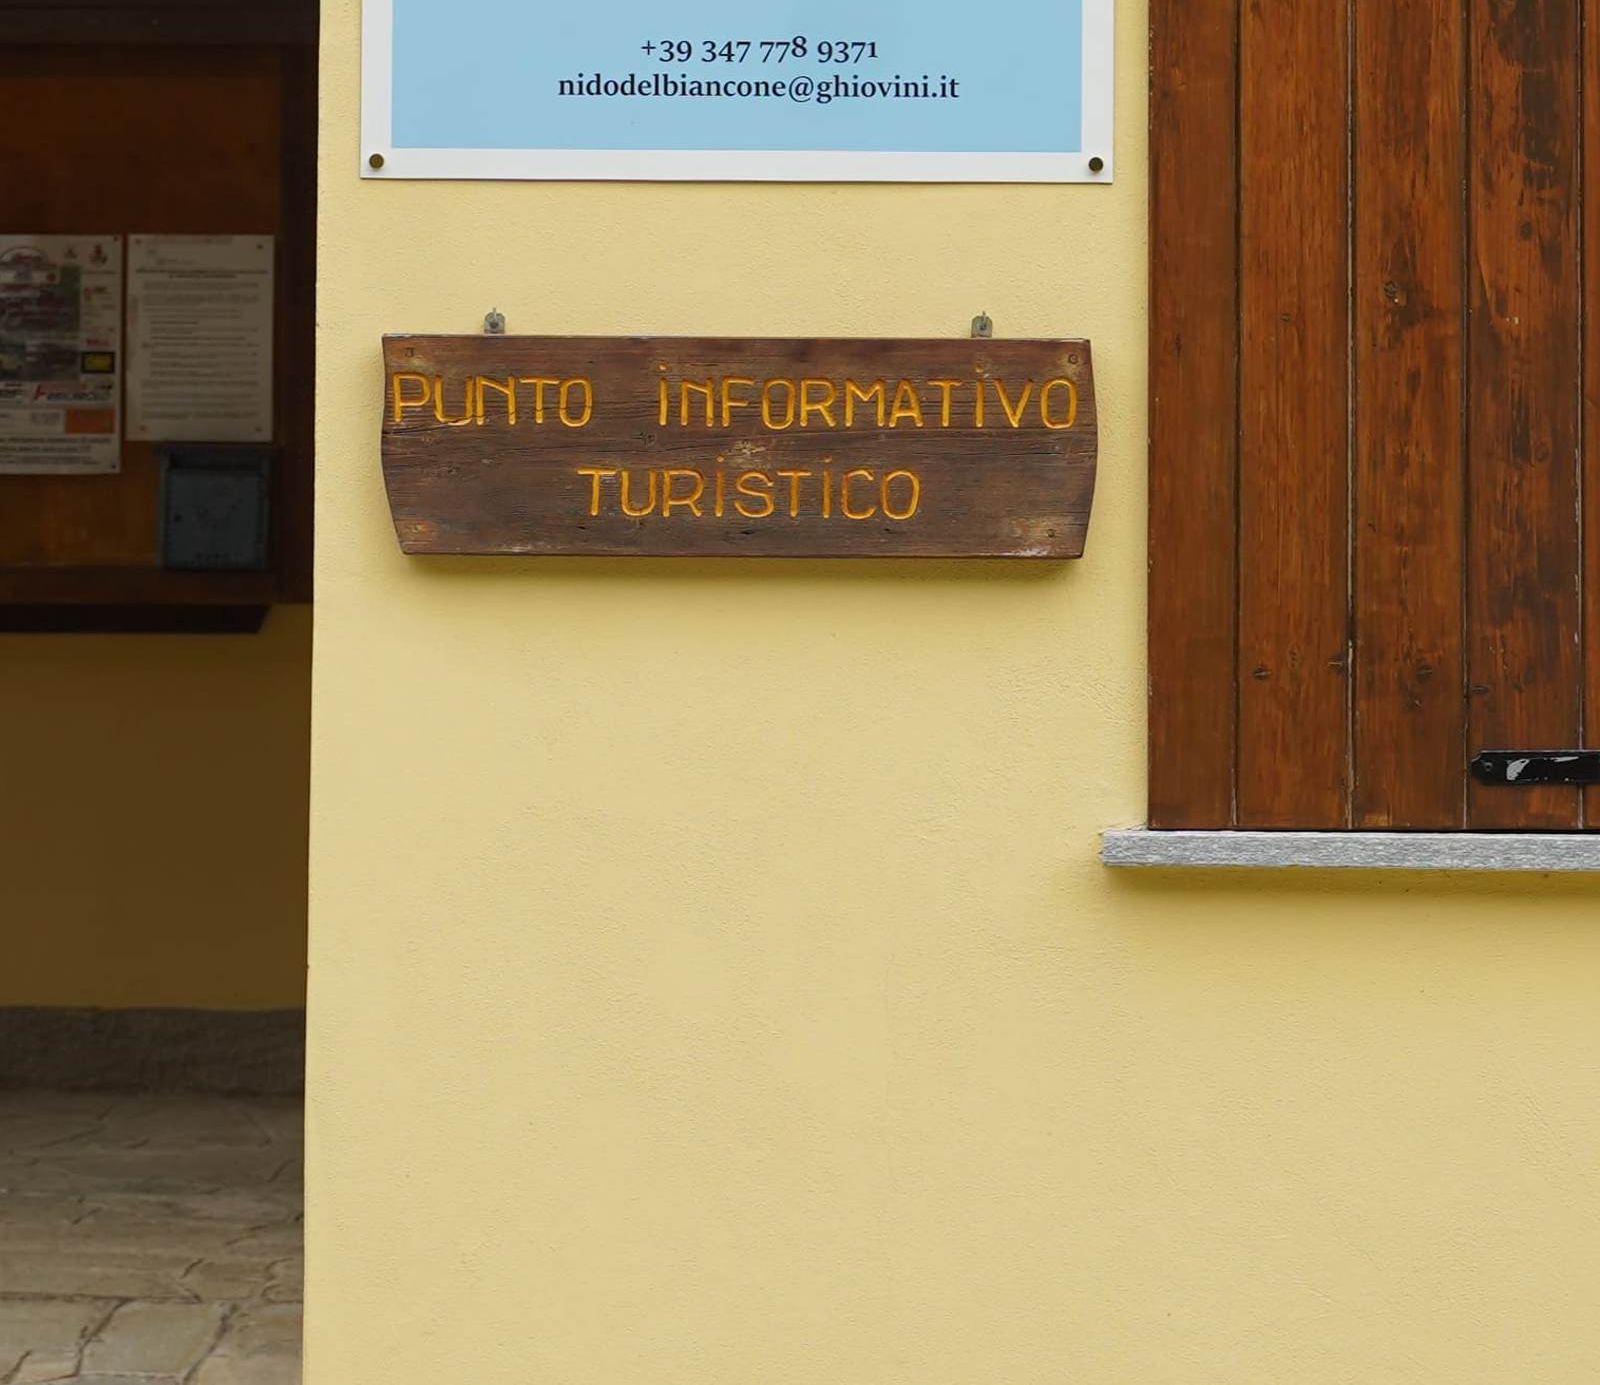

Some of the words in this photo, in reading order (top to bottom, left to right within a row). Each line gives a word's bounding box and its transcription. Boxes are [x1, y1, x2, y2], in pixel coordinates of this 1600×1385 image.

[640, 39, 693, 63] +39
[701, 40, 752, 64] 347
[759, 35, 808, 64] 778
[817, 40, 878, 64] 9371
[558, 72, 960, 105] nidodelbiancone@ghiovini.it
[390, 371, 593, 428] PUNTO
